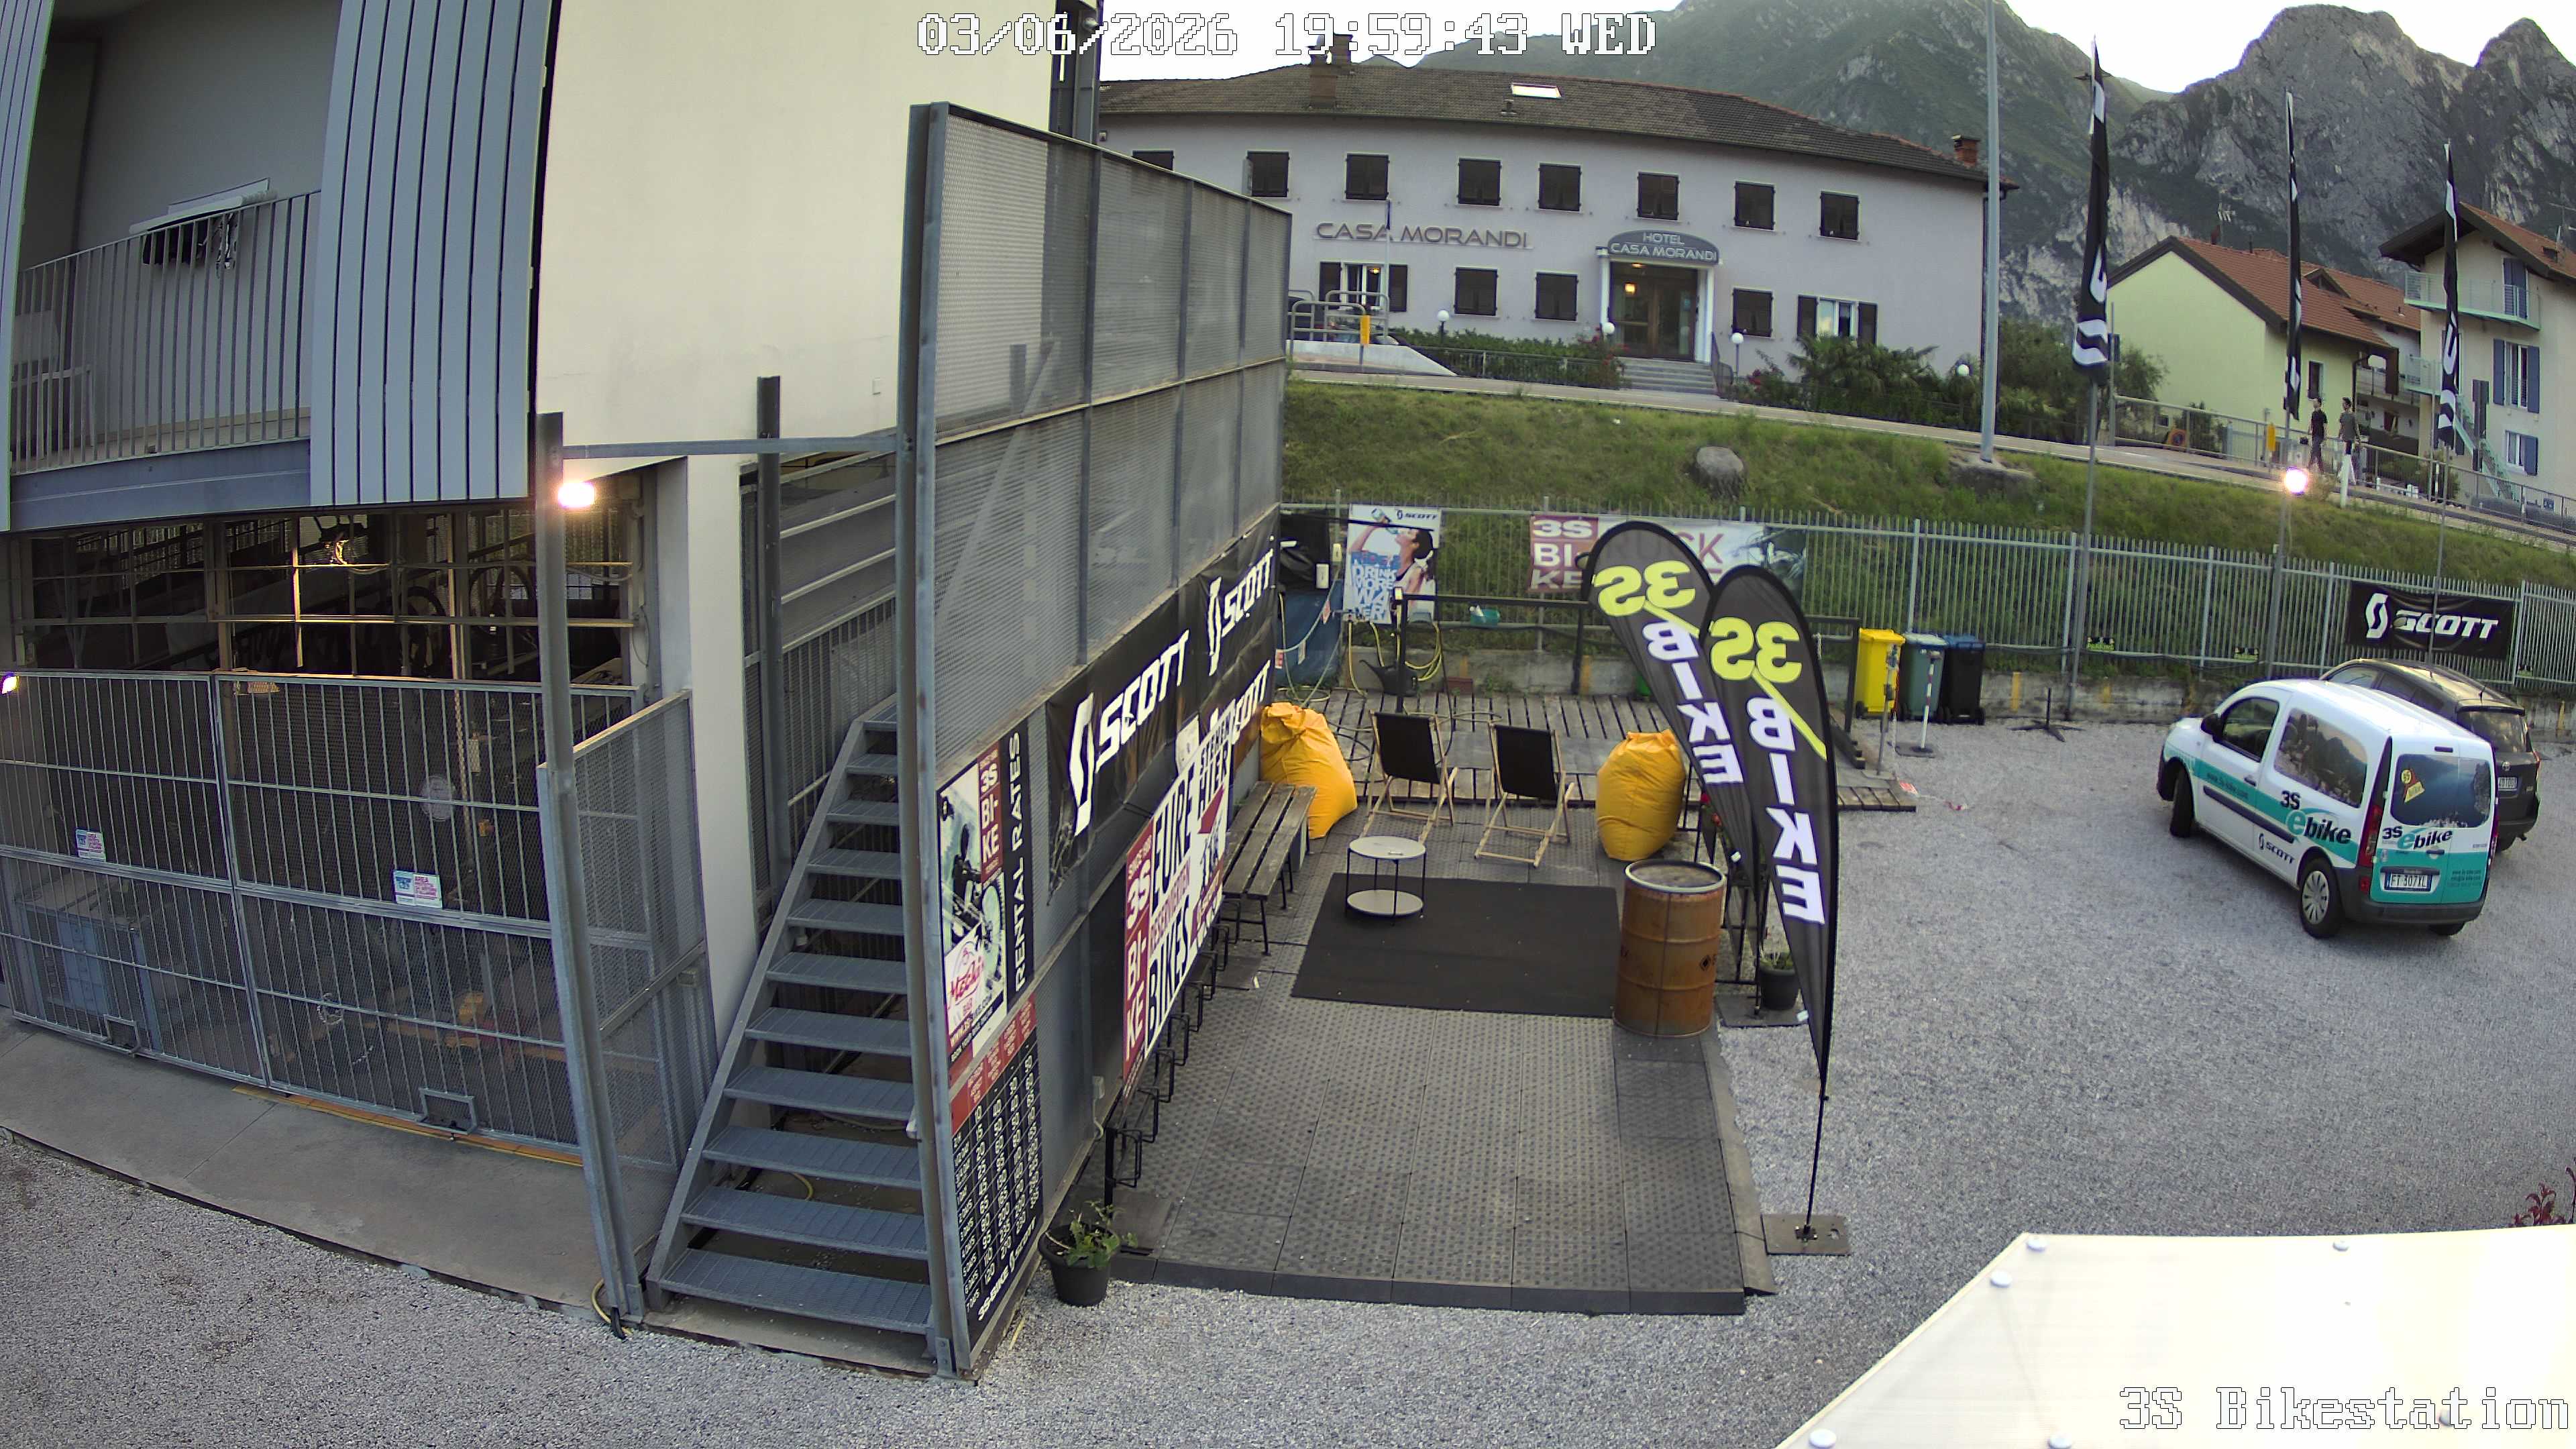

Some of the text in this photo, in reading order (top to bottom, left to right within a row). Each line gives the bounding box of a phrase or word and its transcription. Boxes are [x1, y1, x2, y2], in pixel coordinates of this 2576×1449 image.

[1316, 222, 1527, 248] CASA MORANDI
[1644, 232, 1684, 245] HOTEL
[1611, 243, 1717, 261] CASA MORANDI
[1533, 520, 1593, 538] 3S
[1222, 548, 1273, 637] SCOTT
[2394, 610, 2499, 639] SCOTT
[1095, 629, 1189, 773] SCOTT
[980, 763, 998, 792] 3S
[1009, 733, 1024, 852] RATES
[1197, 740, 1229, 820] HIER
[2281, 790, 2301, 810] 3S
[1151, 762, 1195, 916] EURE
[2286, 809, 2351, 845] ebike
[2382, 826, 2402, 840] 3S
[2398, 829, 2453, 849] ebike
[982, 824, 1000, 863] KE
[2265, 842, 2295, 865] SCOTT
[1127, 859, 1150, 929] 3S
[1012, 857, 1026, 992] RENTAL
[1127, 929, 1146, 1001] BI-
[1148, 894, 1189, 1049] BIKES
[1127, 980, 1144, 1061] KE
[974, 1105, 982, 1124] 10
[975, 1123, 983, 1142] 15
[975, 1141, 985, 1162] 20
[994, 1117, 1003, 1136] 50
[977, 1159, 987, 1180] 25
[995, 1135, 1004, 1155] 60
[979, 1194, 989, 1214] 65
[982, 1229, 991, 1250] 95
